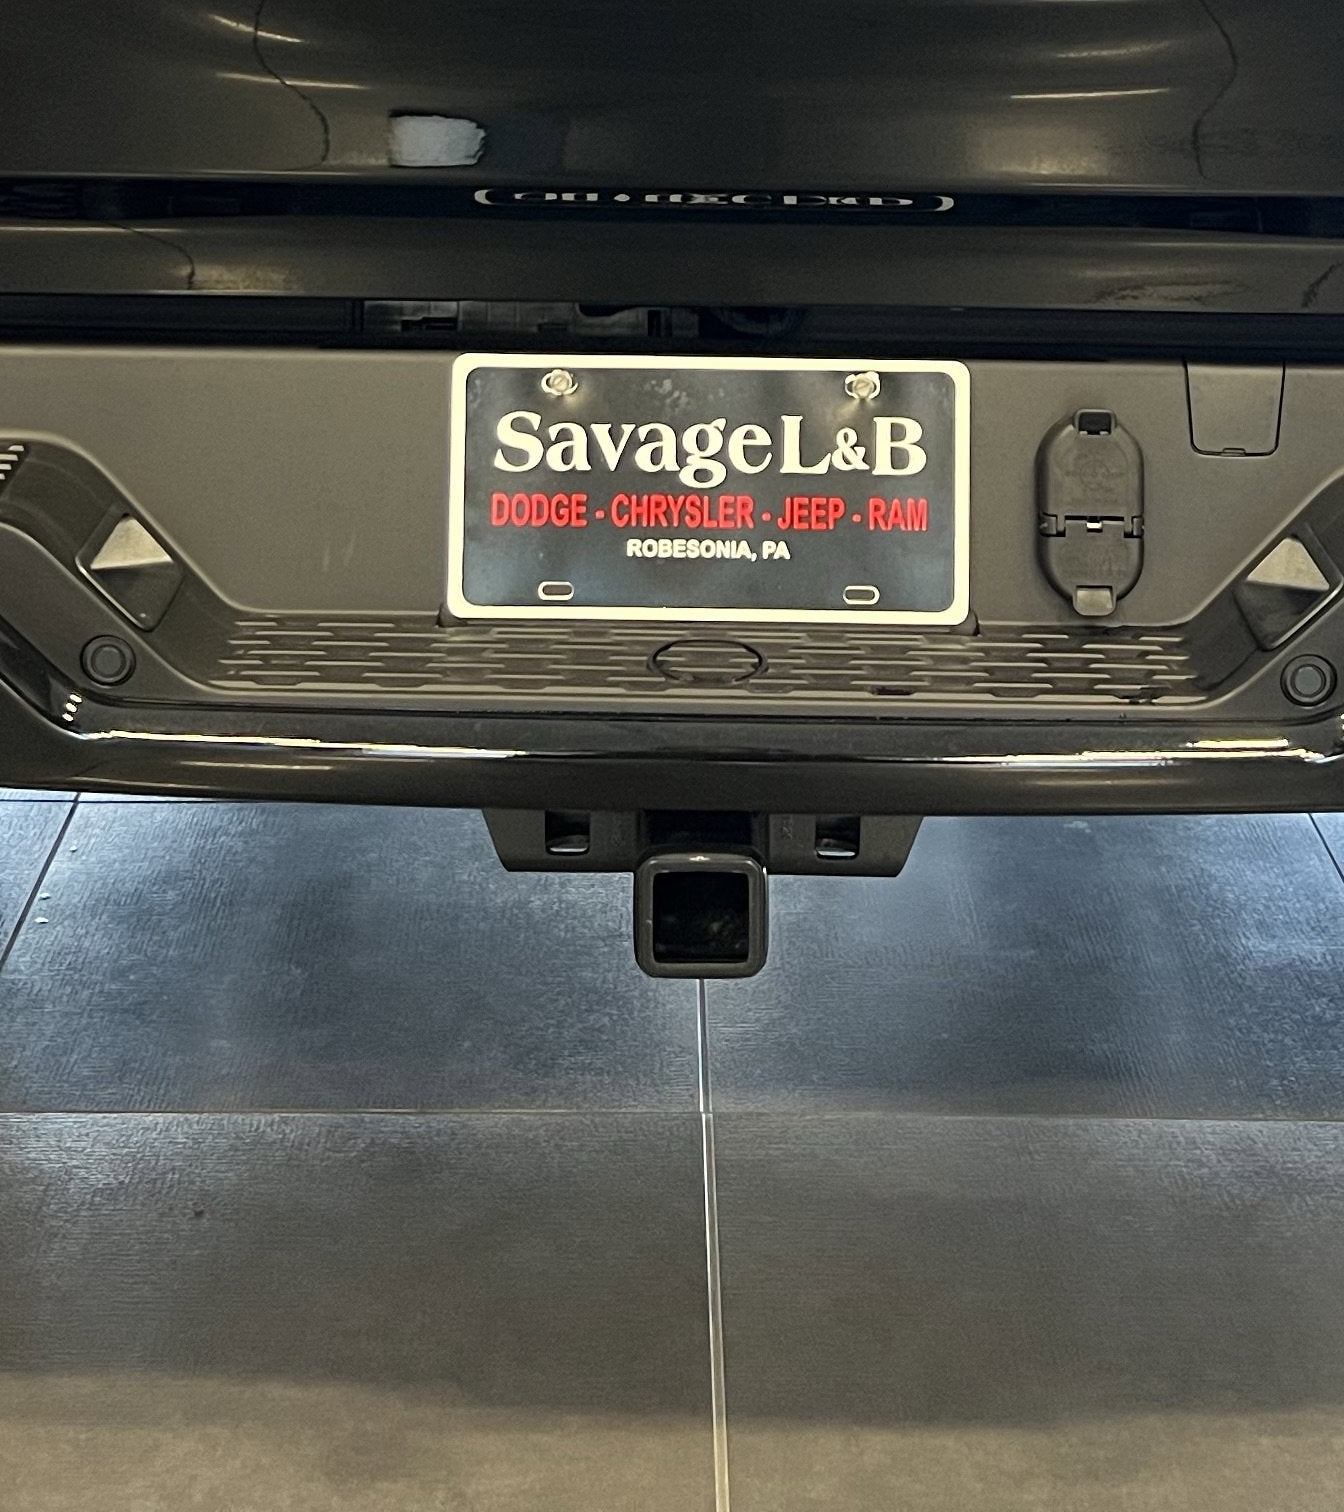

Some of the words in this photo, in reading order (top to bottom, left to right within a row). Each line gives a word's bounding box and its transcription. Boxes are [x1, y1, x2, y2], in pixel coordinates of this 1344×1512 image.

[490, 492, 589, 528] DODGE
[610, 494, 754, 530] CHRYSLER
[777, 496, 845, 531] JEEP
[868, 498, 928, 532] RAM
[626, 538, 757, 562] ROBESONIA,
[762, 540, 791, 561] PA
